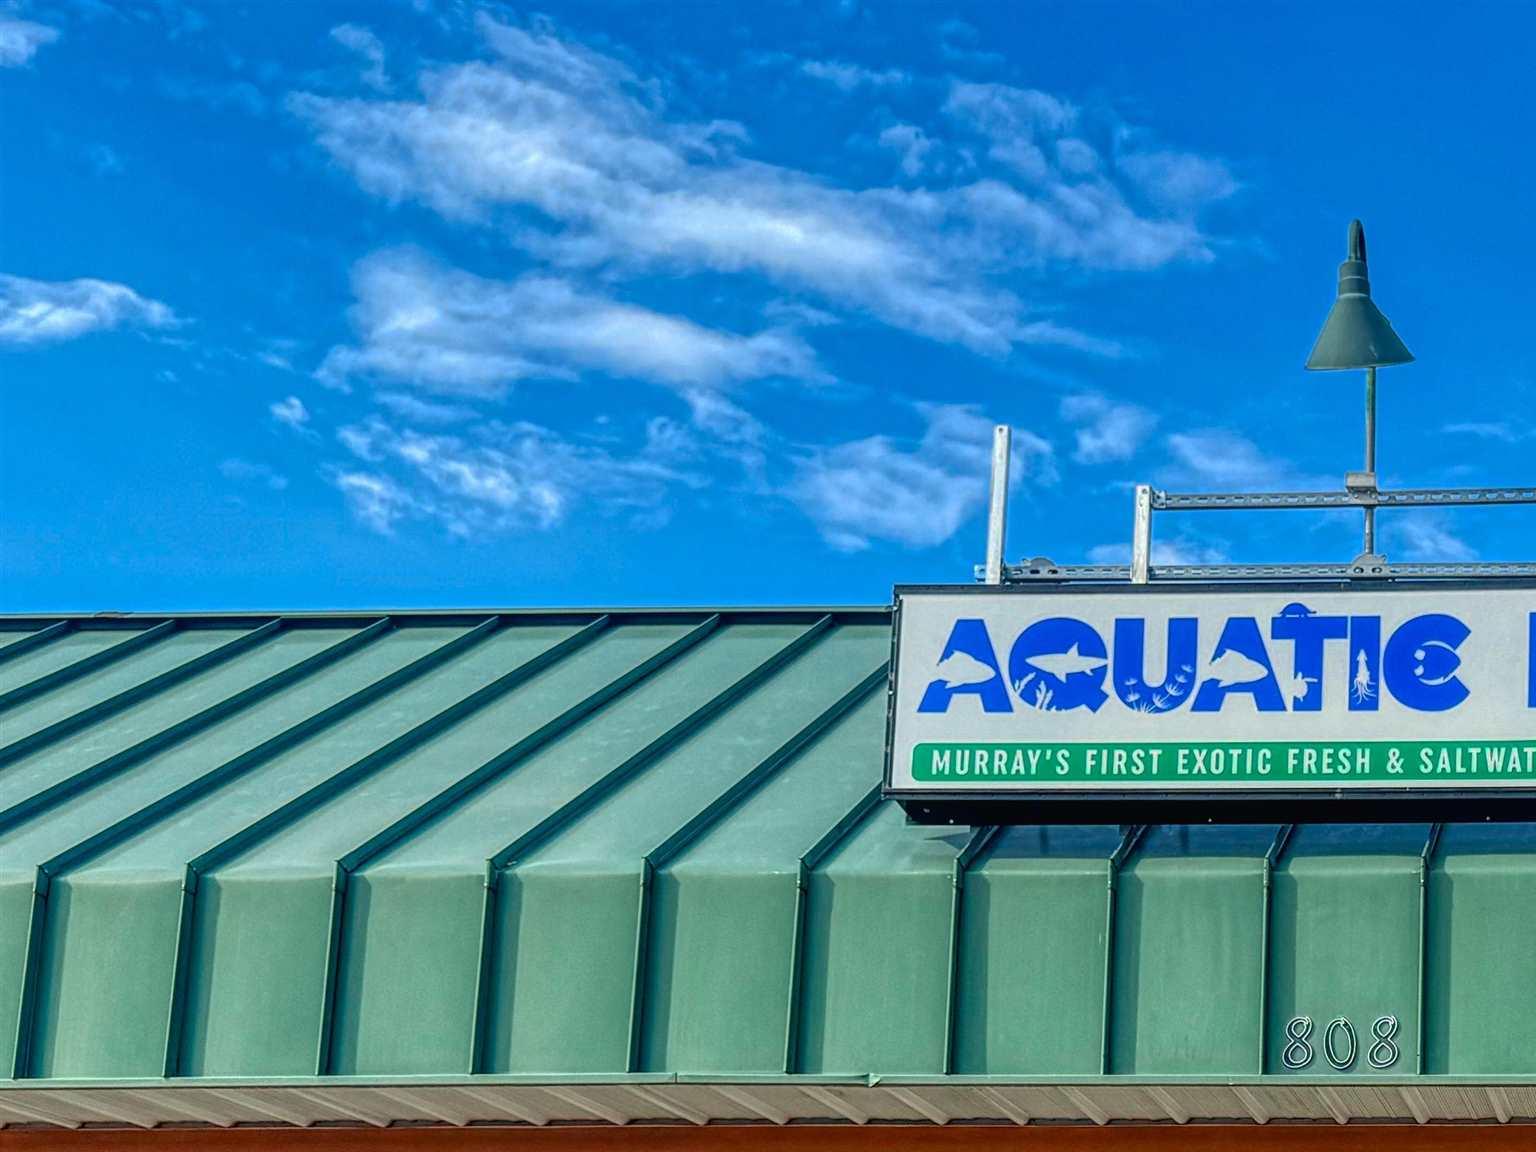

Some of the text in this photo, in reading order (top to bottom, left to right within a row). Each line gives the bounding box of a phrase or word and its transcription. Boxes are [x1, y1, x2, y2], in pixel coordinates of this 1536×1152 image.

[917, 603, 1471, 714] AQUATIC
[930, 749, 1070, 776] MURRAY'S
[1085, 749, 1162, 775] FIRST
[1177, 748, 1271, 775] EXOTIC
[1287, 748, 1370, 774] FRESH
[1386, 748, 1404, 774] &
[1282, 1016, 1400, 1070] 808
